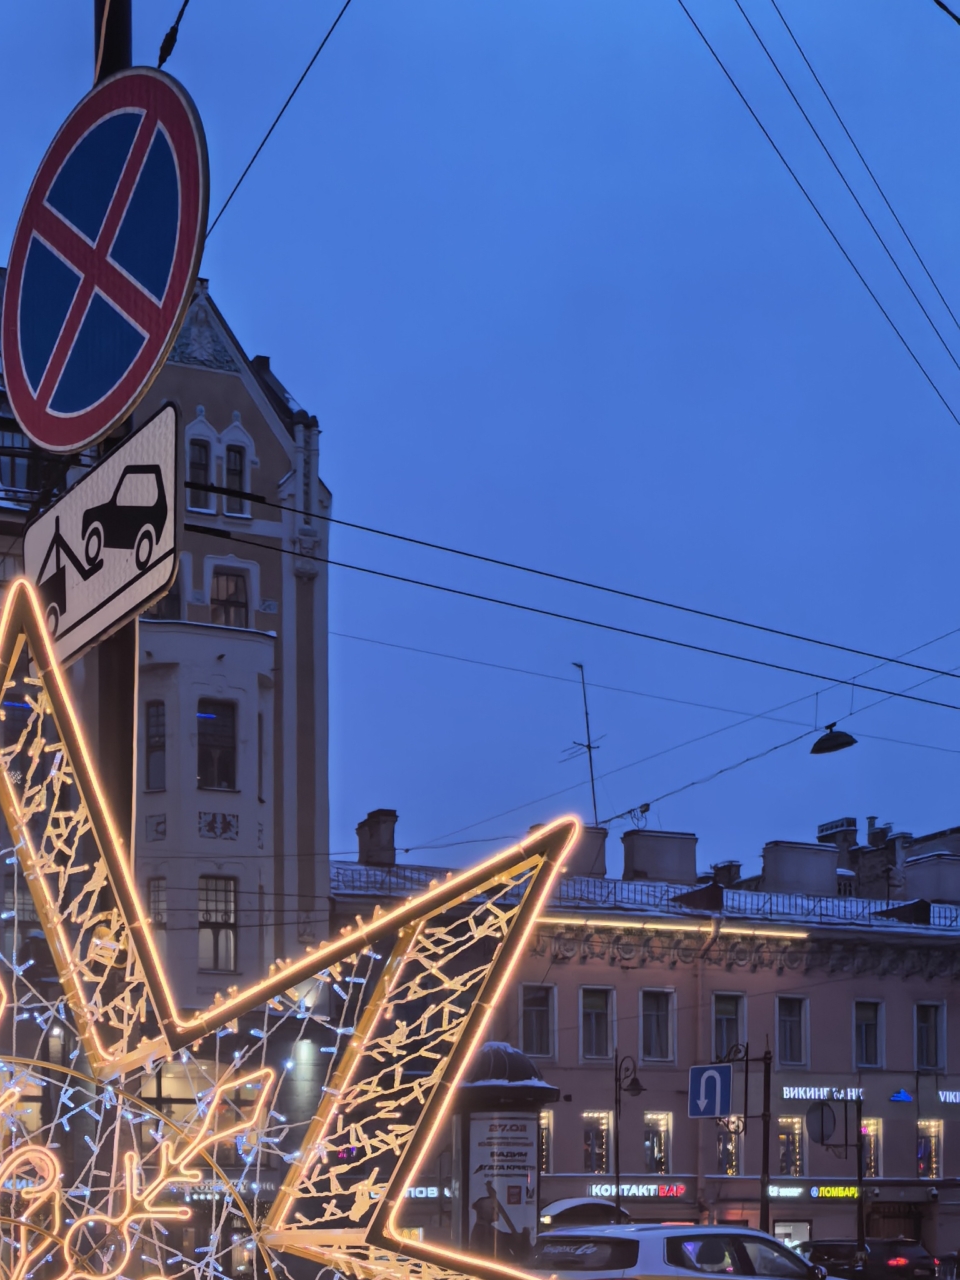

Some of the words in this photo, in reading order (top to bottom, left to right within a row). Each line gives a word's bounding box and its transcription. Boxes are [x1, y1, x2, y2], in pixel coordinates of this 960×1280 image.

[782, 1086, 830, 1100] ВИКИНГ
[938, 1090, 960, 1103] VIKI
[591, 1184, 658, 1197] КОНТАКТ
